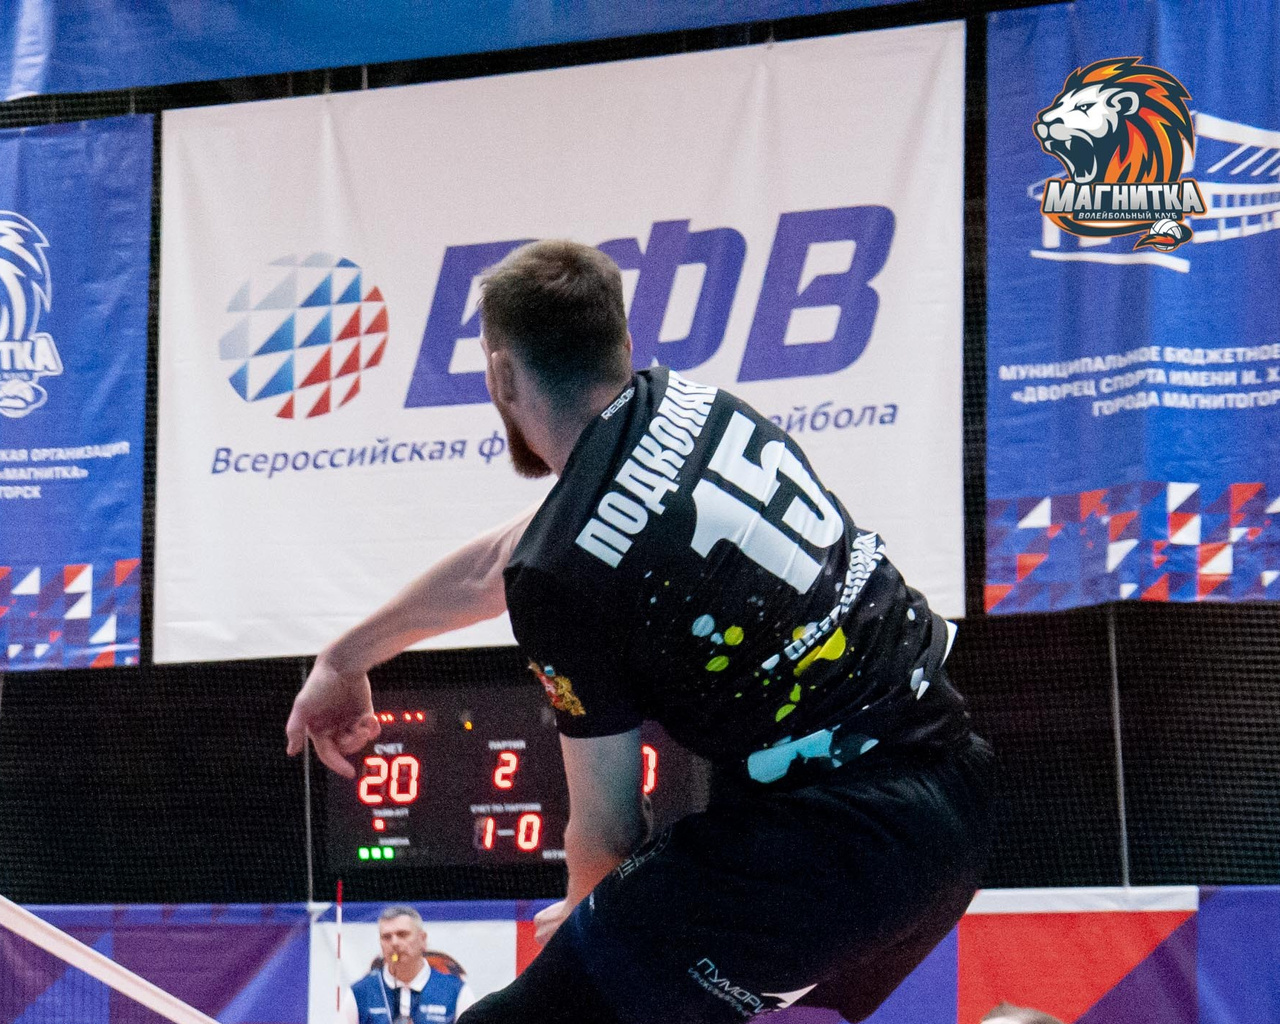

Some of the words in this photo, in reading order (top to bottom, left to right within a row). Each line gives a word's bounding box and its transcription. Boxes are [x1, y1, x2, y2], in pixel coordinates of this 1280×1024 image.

[999, 345, 1162, 381] МУНИЦИПАЛЬНОЕ
[1163, 343, 1280, 366] БЮДЖЕТНОЕ
[1011, 379, 1097, 404] «ДВОРЕЦ
[1100, 368, 1167, 394] СПОРТА
[1169, 370, 1238, 387] ИМЕНИ
[1091, 391, 1160, 417] ГОРОДА
[1162, 388, 1280, 410] МАГНИТОГОР
[211, 435, 468, 479] Всероссийская
[690, 411, 845, 595] 15
[359, 755, 419, 803] 20
[493, 751, 518, 789] 2
